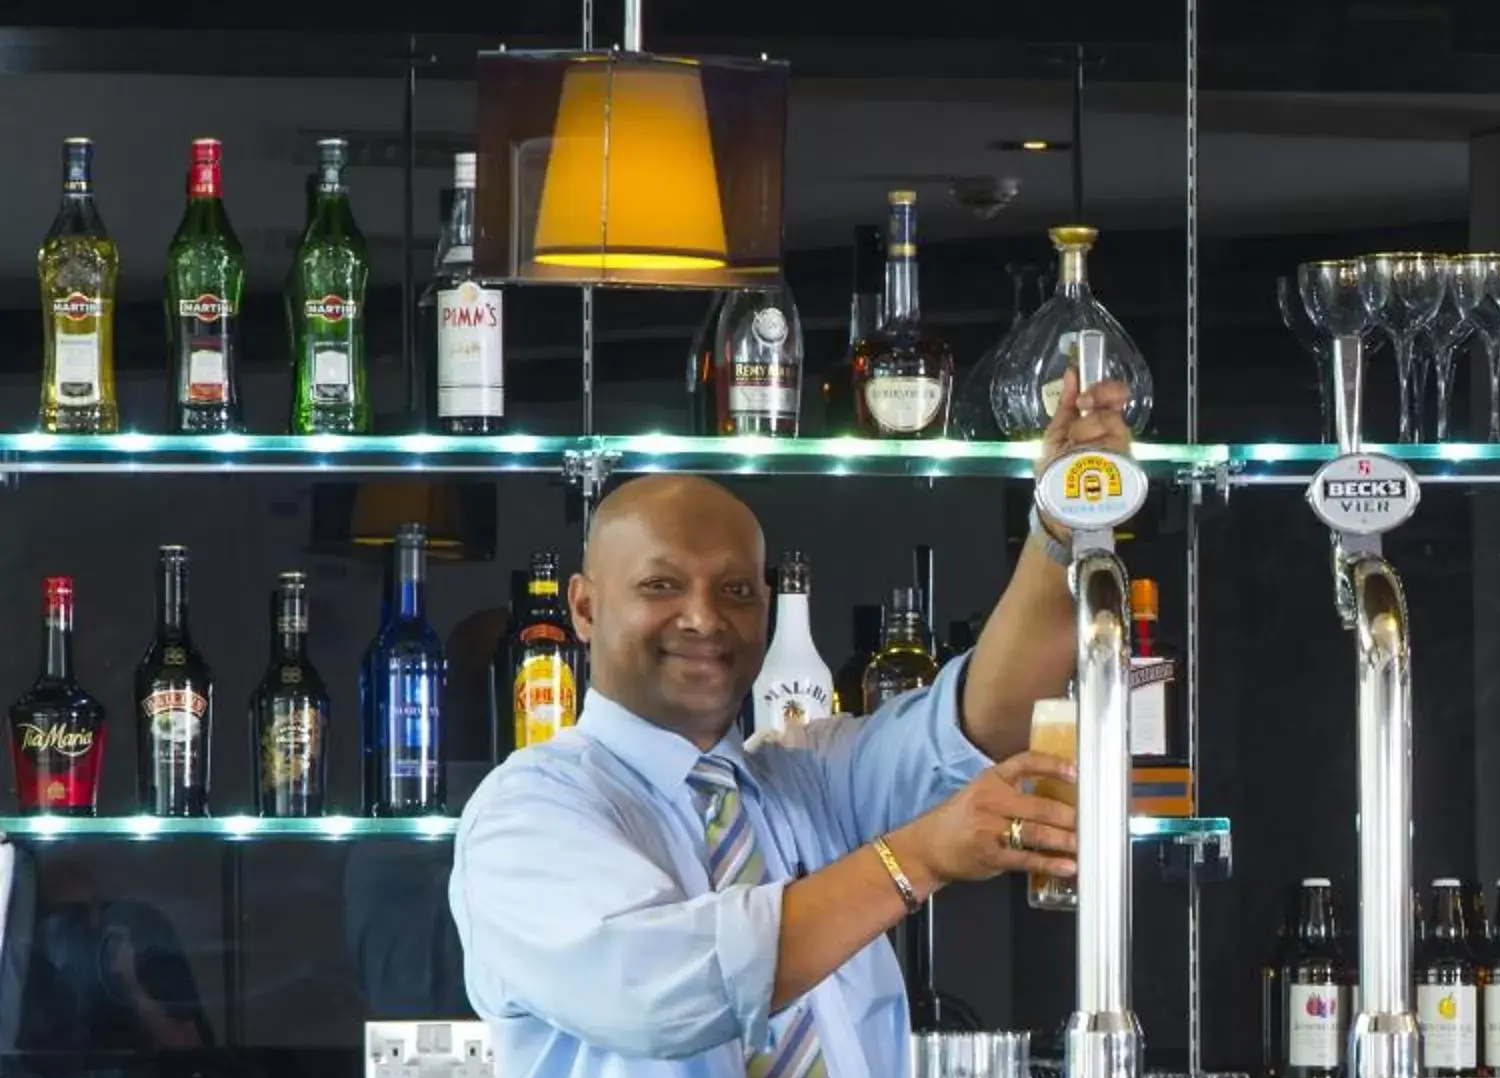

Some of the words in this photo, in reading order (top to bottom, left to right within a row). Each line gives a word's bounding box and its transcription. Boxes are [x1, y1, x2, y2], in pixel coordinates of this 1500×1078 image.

[442, 303, 498, 327] PIMM'S
[1328, 480, 1402, 498] BECK'S
[1340, 500, 1391, 513] VIER
[17, 723, 48, 751] Tia
[43, 722, 94, 752] Maria
